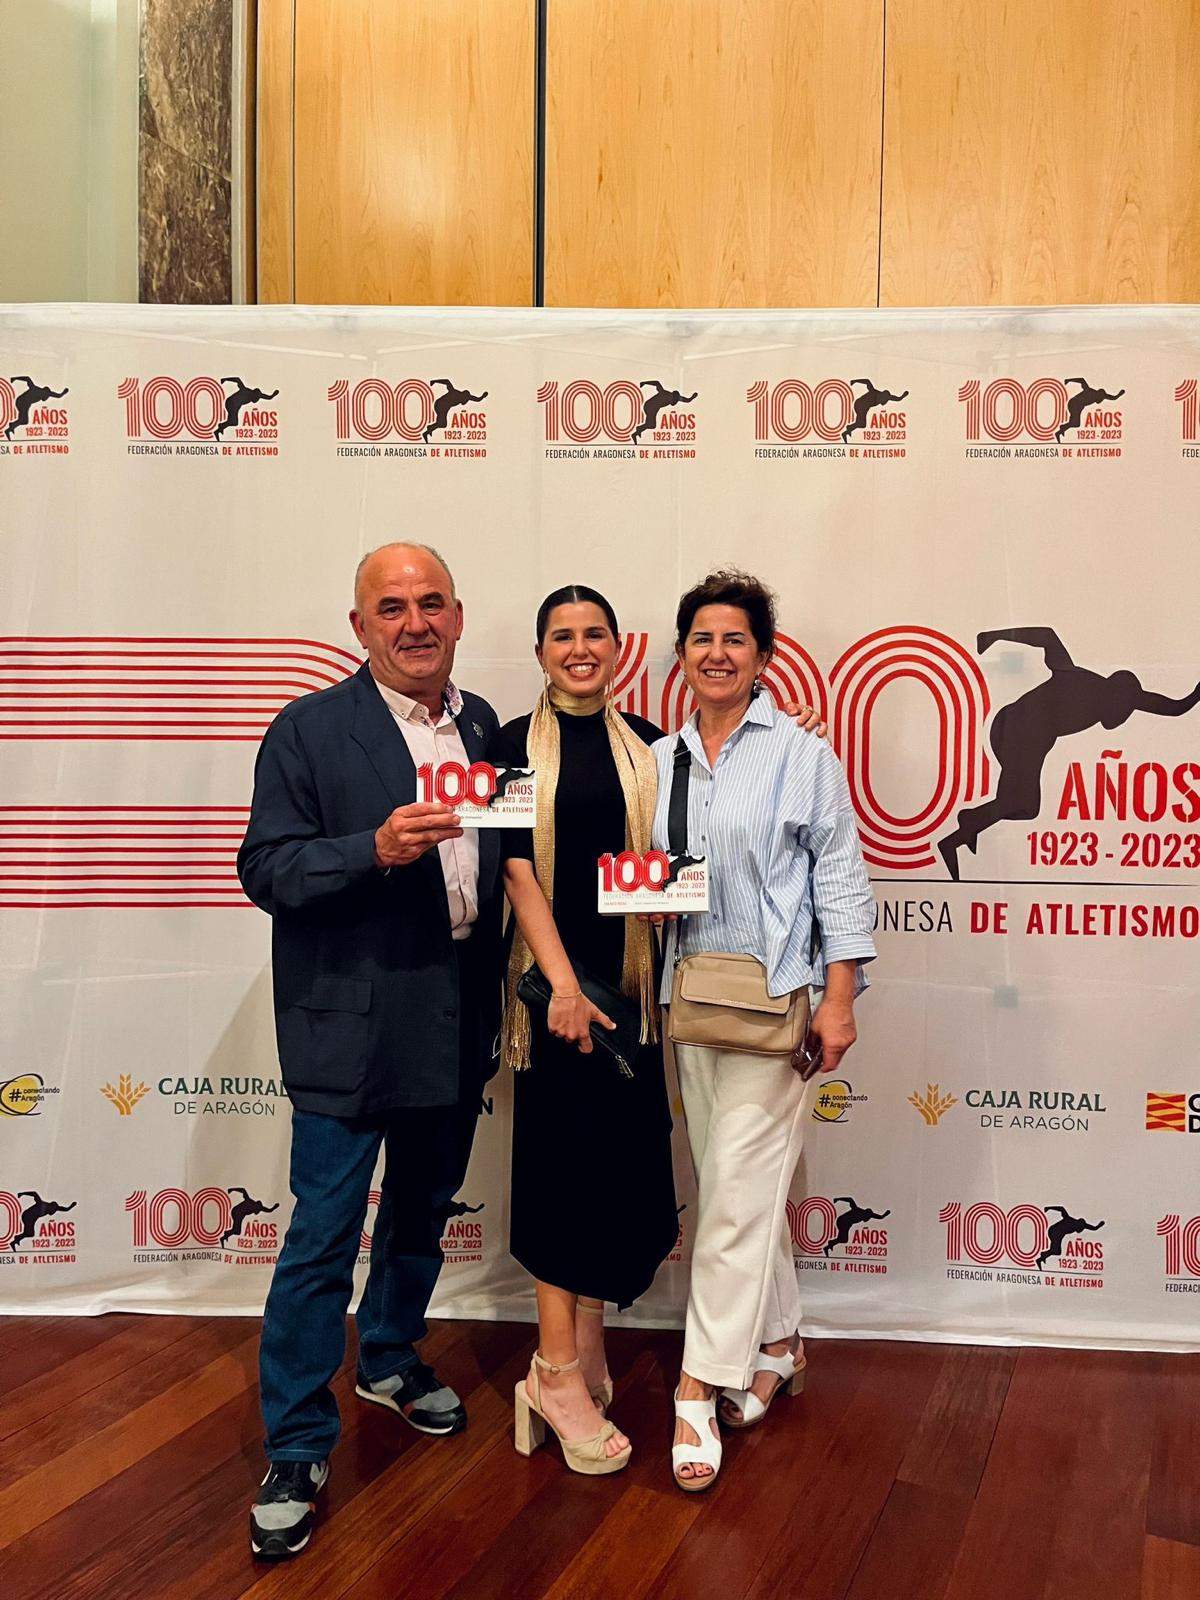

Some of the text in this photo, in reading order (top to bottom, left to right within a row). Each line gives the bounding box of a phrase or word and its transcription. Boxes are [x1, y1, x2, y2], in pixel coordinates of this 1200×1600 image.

[33, 406, 67, 424] AÑOS
[242, 408, 278, 426] AÑOS
[451, 410, 486, 429] AÑOS
[660, 410, 696, 429] AÑOS
[870, 410, 906, 428] AÑOS
[1085, 408, 1122, 428] AÑOS
[14, 446, 23, 454] DE
[27, 445, 69, 454] ATLETISMO
[127, 444, 278, 456] FEDERACIÓN ARAGONESA DE ATLETISMO
[336, 446, 487, 458] FEDERACIÓN ARAGONESA DE ATLETISMO
[545, 448, 696, 459] FEDERACIÓN ARAGONESA DE ATLETISMO
[754, 446, 906, 458] FEDERACIÓN ARAGONESA DE ATLETISMO
[965, 446, 1122, 459] FEDERACIÓN ARAGONESA DE ATLETISMO
[417, 761, 497, 806] 100
[507, 782, 533, 795] AÑOS
[1057, 750, 1200, 822] AÑOS
[598, 850, 670, 892] 100
[971, 902, 1008, 934] DE
[1026, 903, 1200, 938] ATLETISMO
[158, 1078, 213, 1095] CAJA
[174, 1100, 275, 1115] DE ARAGÓN
[965, 1089, 1106, 1112] CAJA RURAL
[980, 1113, 1088, 1131] DE ARAGÓN
[40, 1219, 75, 1236] AÑOS
[244, 1219, 277, 1238] AÑOS
[447, 1221, 482, 1238] AÑOS
[852, 1227, 887, 1245] AÑOS
[1066, 1238, 1103, 1258] AÑOS
[19, 1256, 28, 1264] DE
[33, 1255, 76, 1263] ATLETISMO
[133, 1252, 278, 1265] FEDERACIÓN ARAGONESA DE ATLETISMO
[831, 1262, 840, 1271] DE
[844, 1263, 887, 1274] ATLETISMO
[947, 1268, 1104, 1288] FEDERACIÓN ARAGONESA DE ATLETISMO
